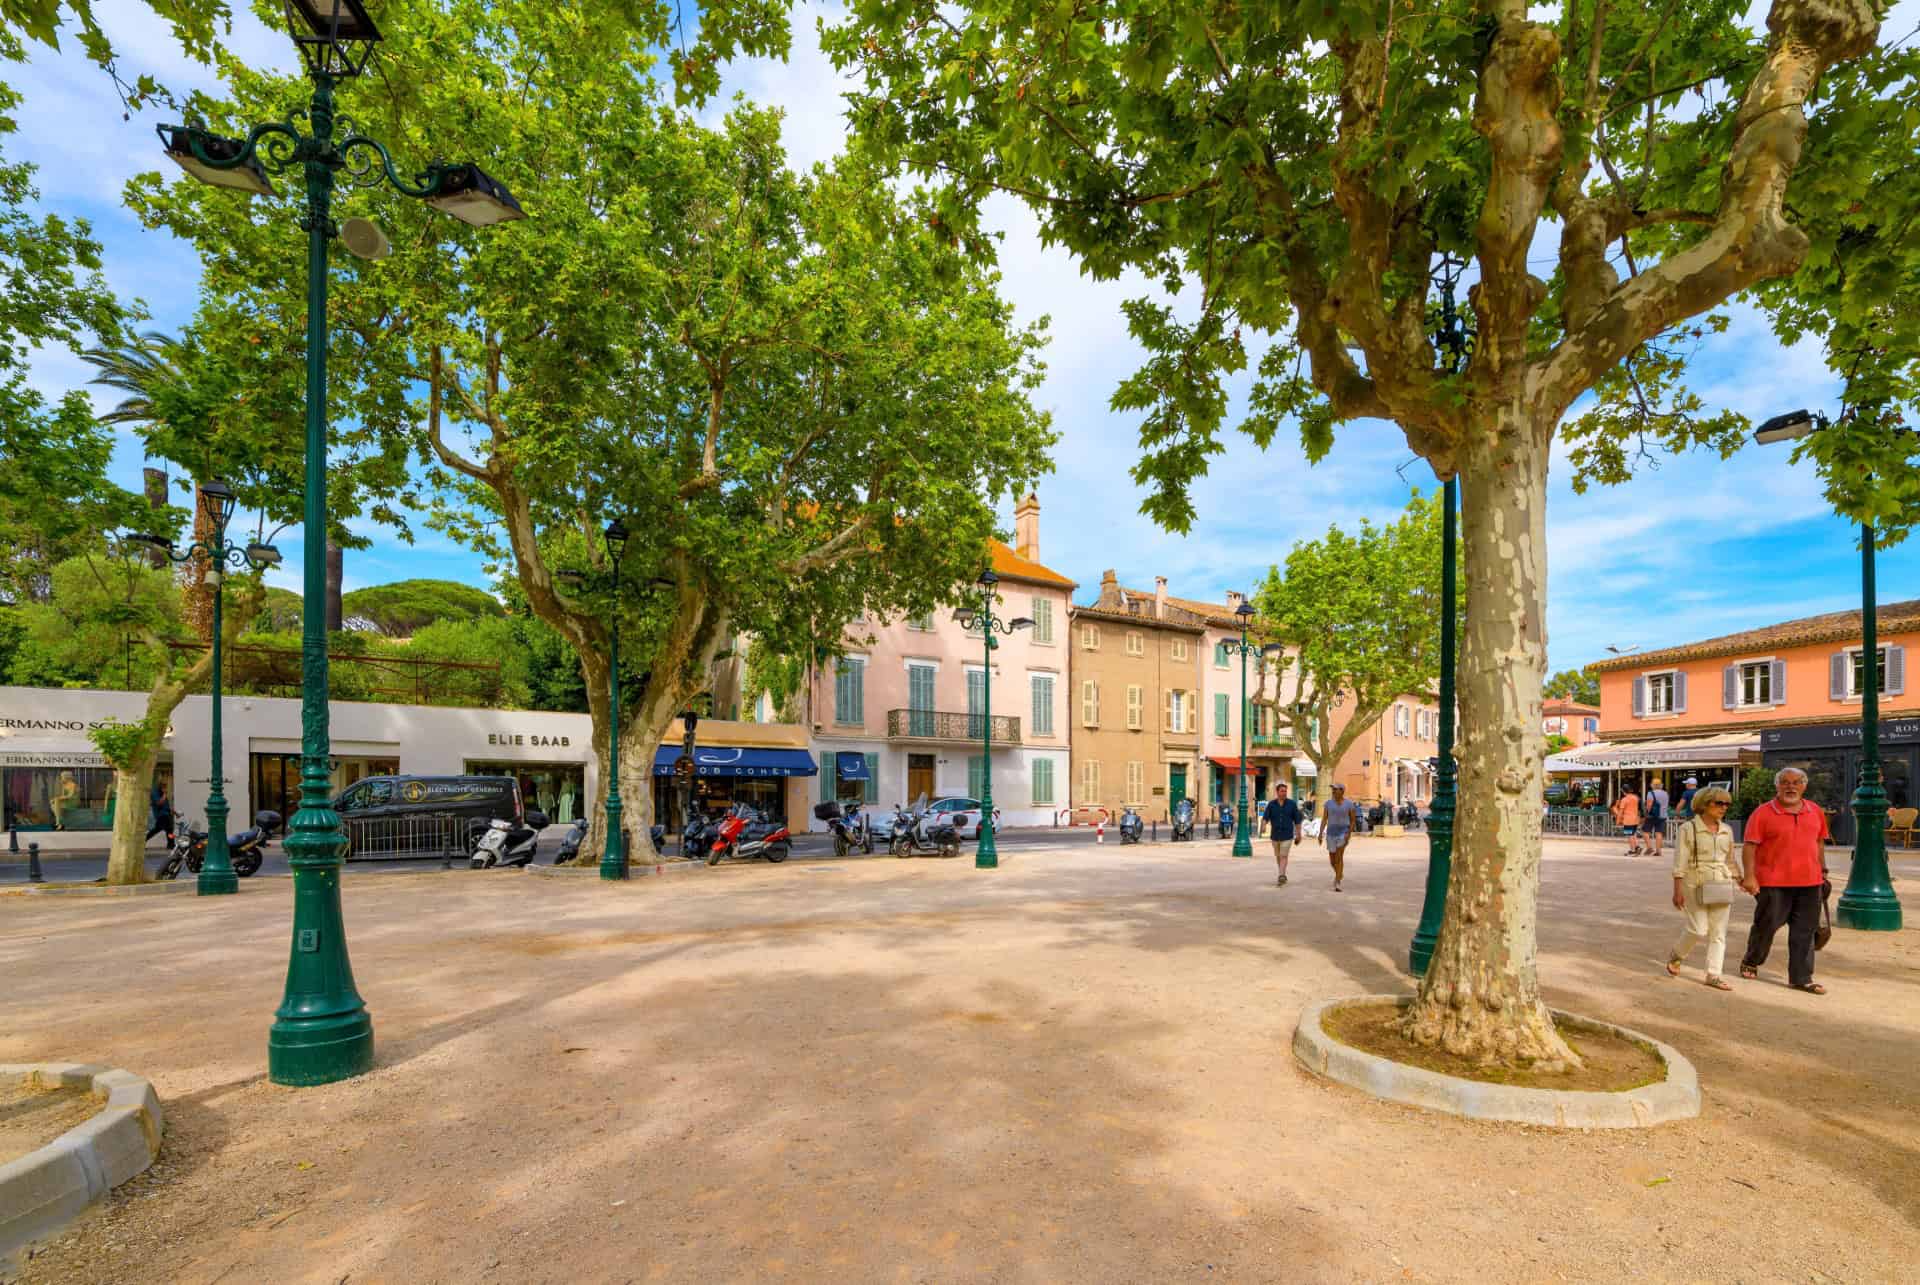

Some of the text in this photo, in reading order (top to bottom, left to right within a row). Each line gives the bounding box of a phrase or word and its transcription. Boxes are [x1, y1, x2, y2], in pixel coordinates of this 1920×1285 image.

[1833, 727, 1863, 737] LUNA
[488, 734, 570, 746] ELIE SAAB
[660, 766, 791, 776] JOB COHEN
